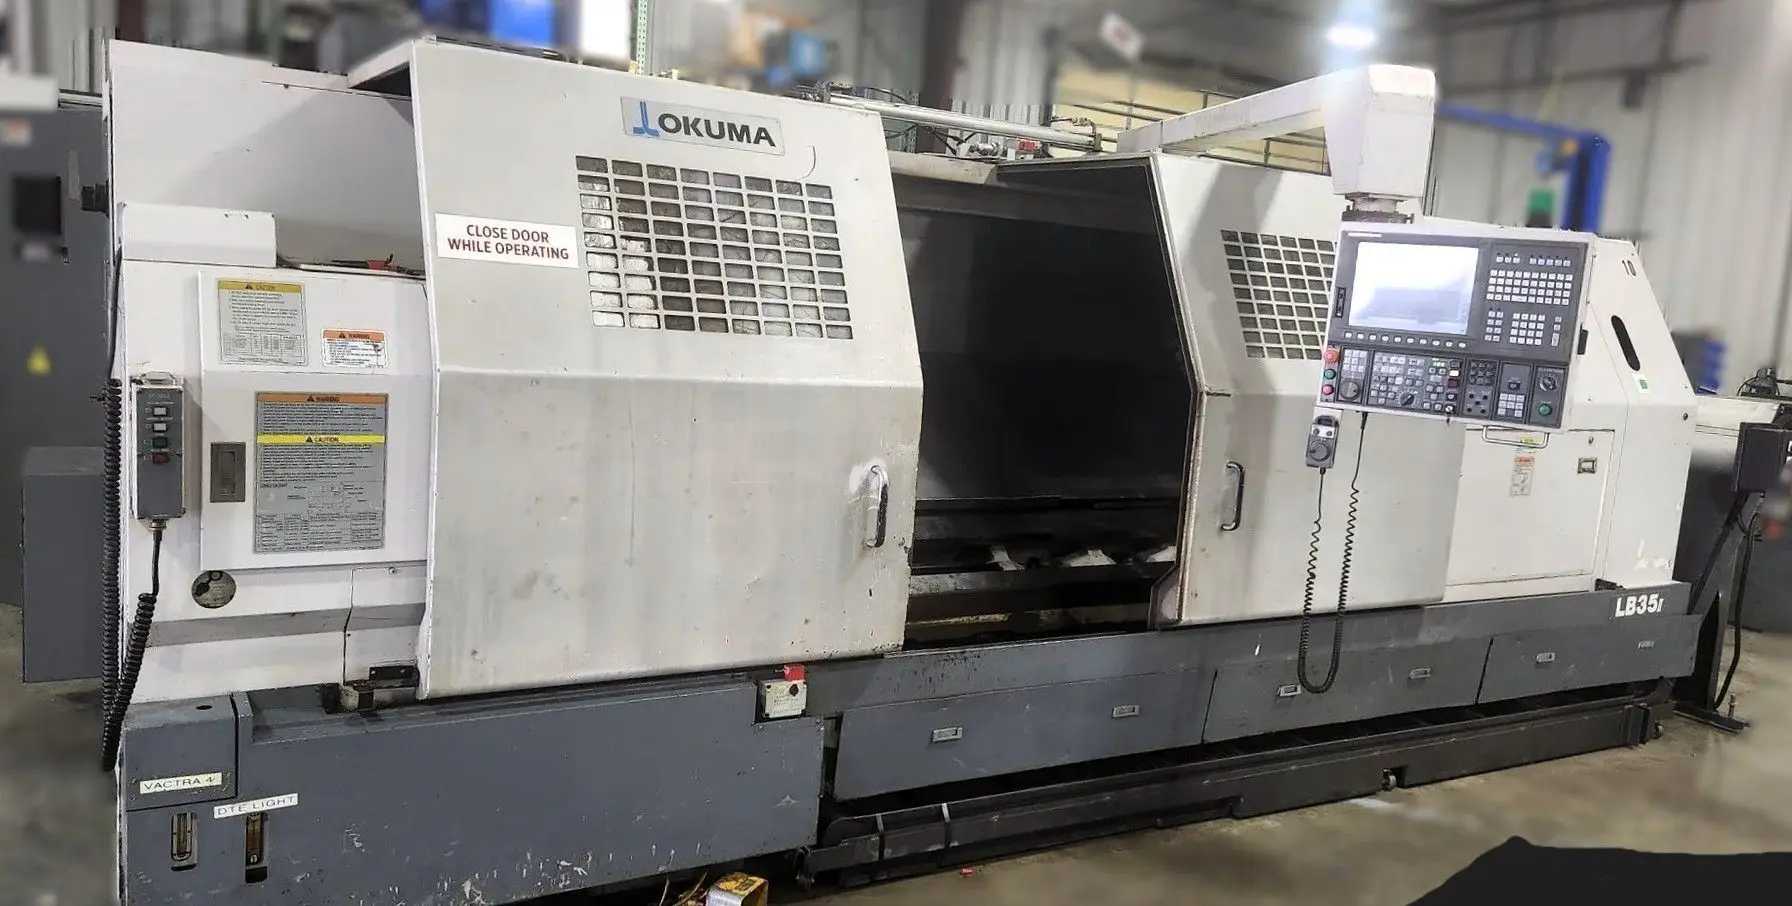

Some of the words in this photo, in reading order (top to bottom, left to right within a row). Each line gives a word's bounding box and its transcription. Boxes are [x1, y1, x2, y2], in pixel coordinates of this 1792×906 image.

[658, 113, 776, 147] OKUMA
[467, 224, 508, 239] CLOSE
[511, 228, 549, 243] DOOR
[448, 238, 492, 253] WHILE
[495, 242, 569, 260] OPERATING
[1621, 259, 1637, 276] 10
[144, 777, 201, 790] VACTRA
[217, 803, 247, 816] DTE
[252, 797, 297, 811] LIGHT
